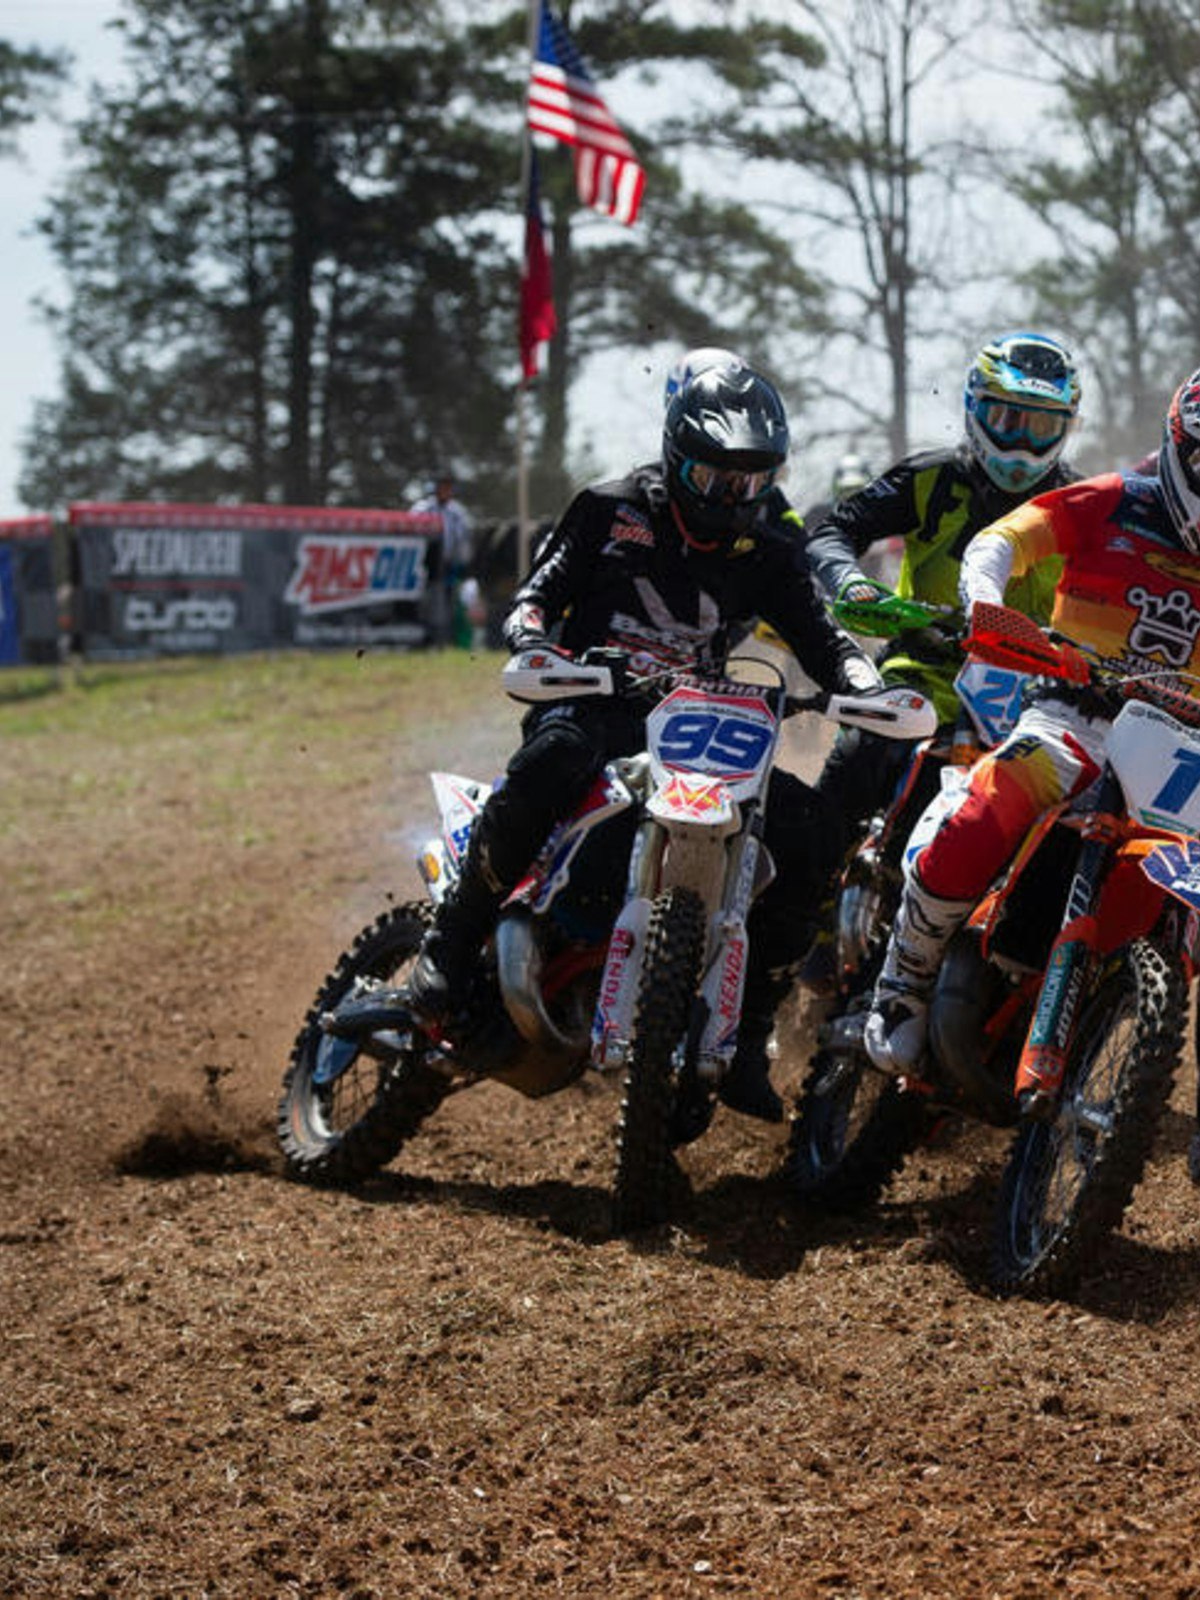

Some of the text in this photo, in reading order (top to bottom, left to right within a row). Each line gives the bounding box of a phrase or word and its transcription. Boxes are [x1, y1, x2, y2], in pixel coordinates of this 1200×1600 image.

[295, 544, 418, 605] AMSOIL
[656, 713, 773, 770] 99
[602, 928, 629, 1009] KENDA
[718, 938, 745, 1020] KENDA
[1056, 960, 1085, 1048] UNLOP
